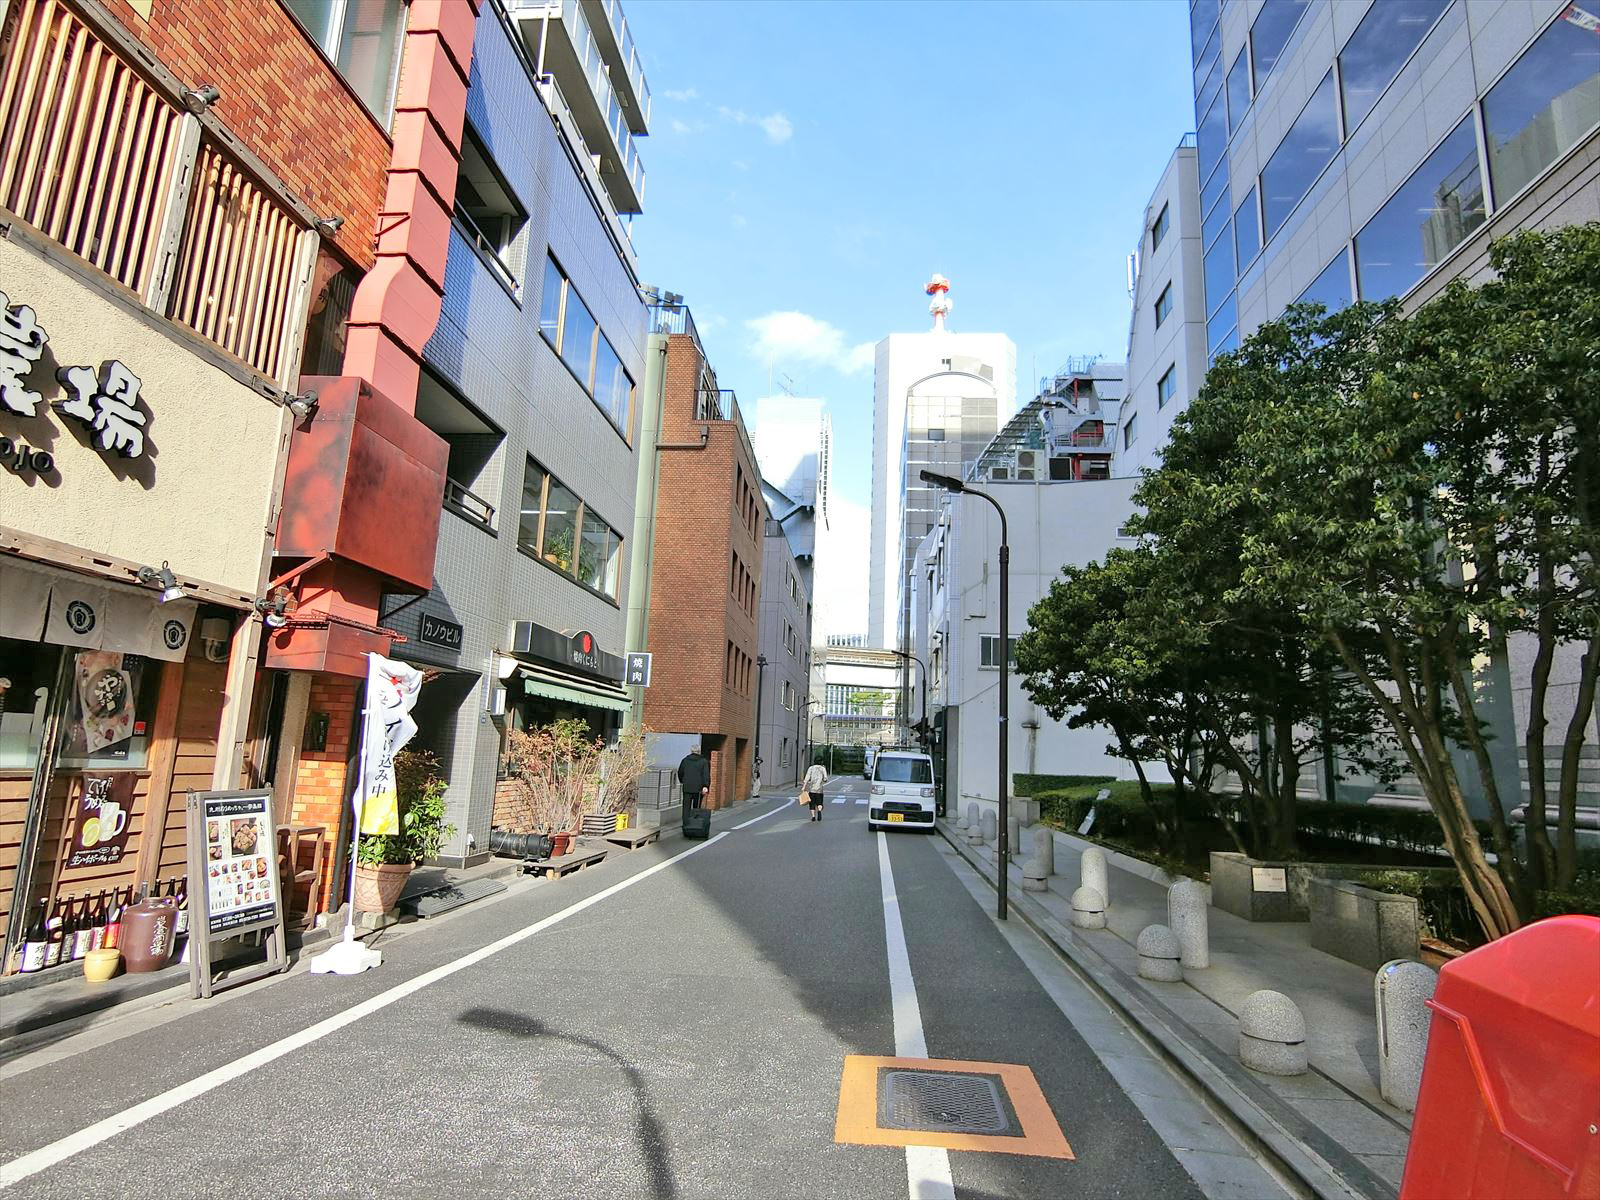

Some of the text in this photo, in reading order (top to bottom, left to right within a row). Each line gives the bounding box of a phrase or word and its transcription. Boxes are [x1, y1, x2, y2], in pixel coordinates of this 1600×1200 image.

[424, 620, 461, 643] カノウビル
[632, 657, 643, 682] 焼肉
